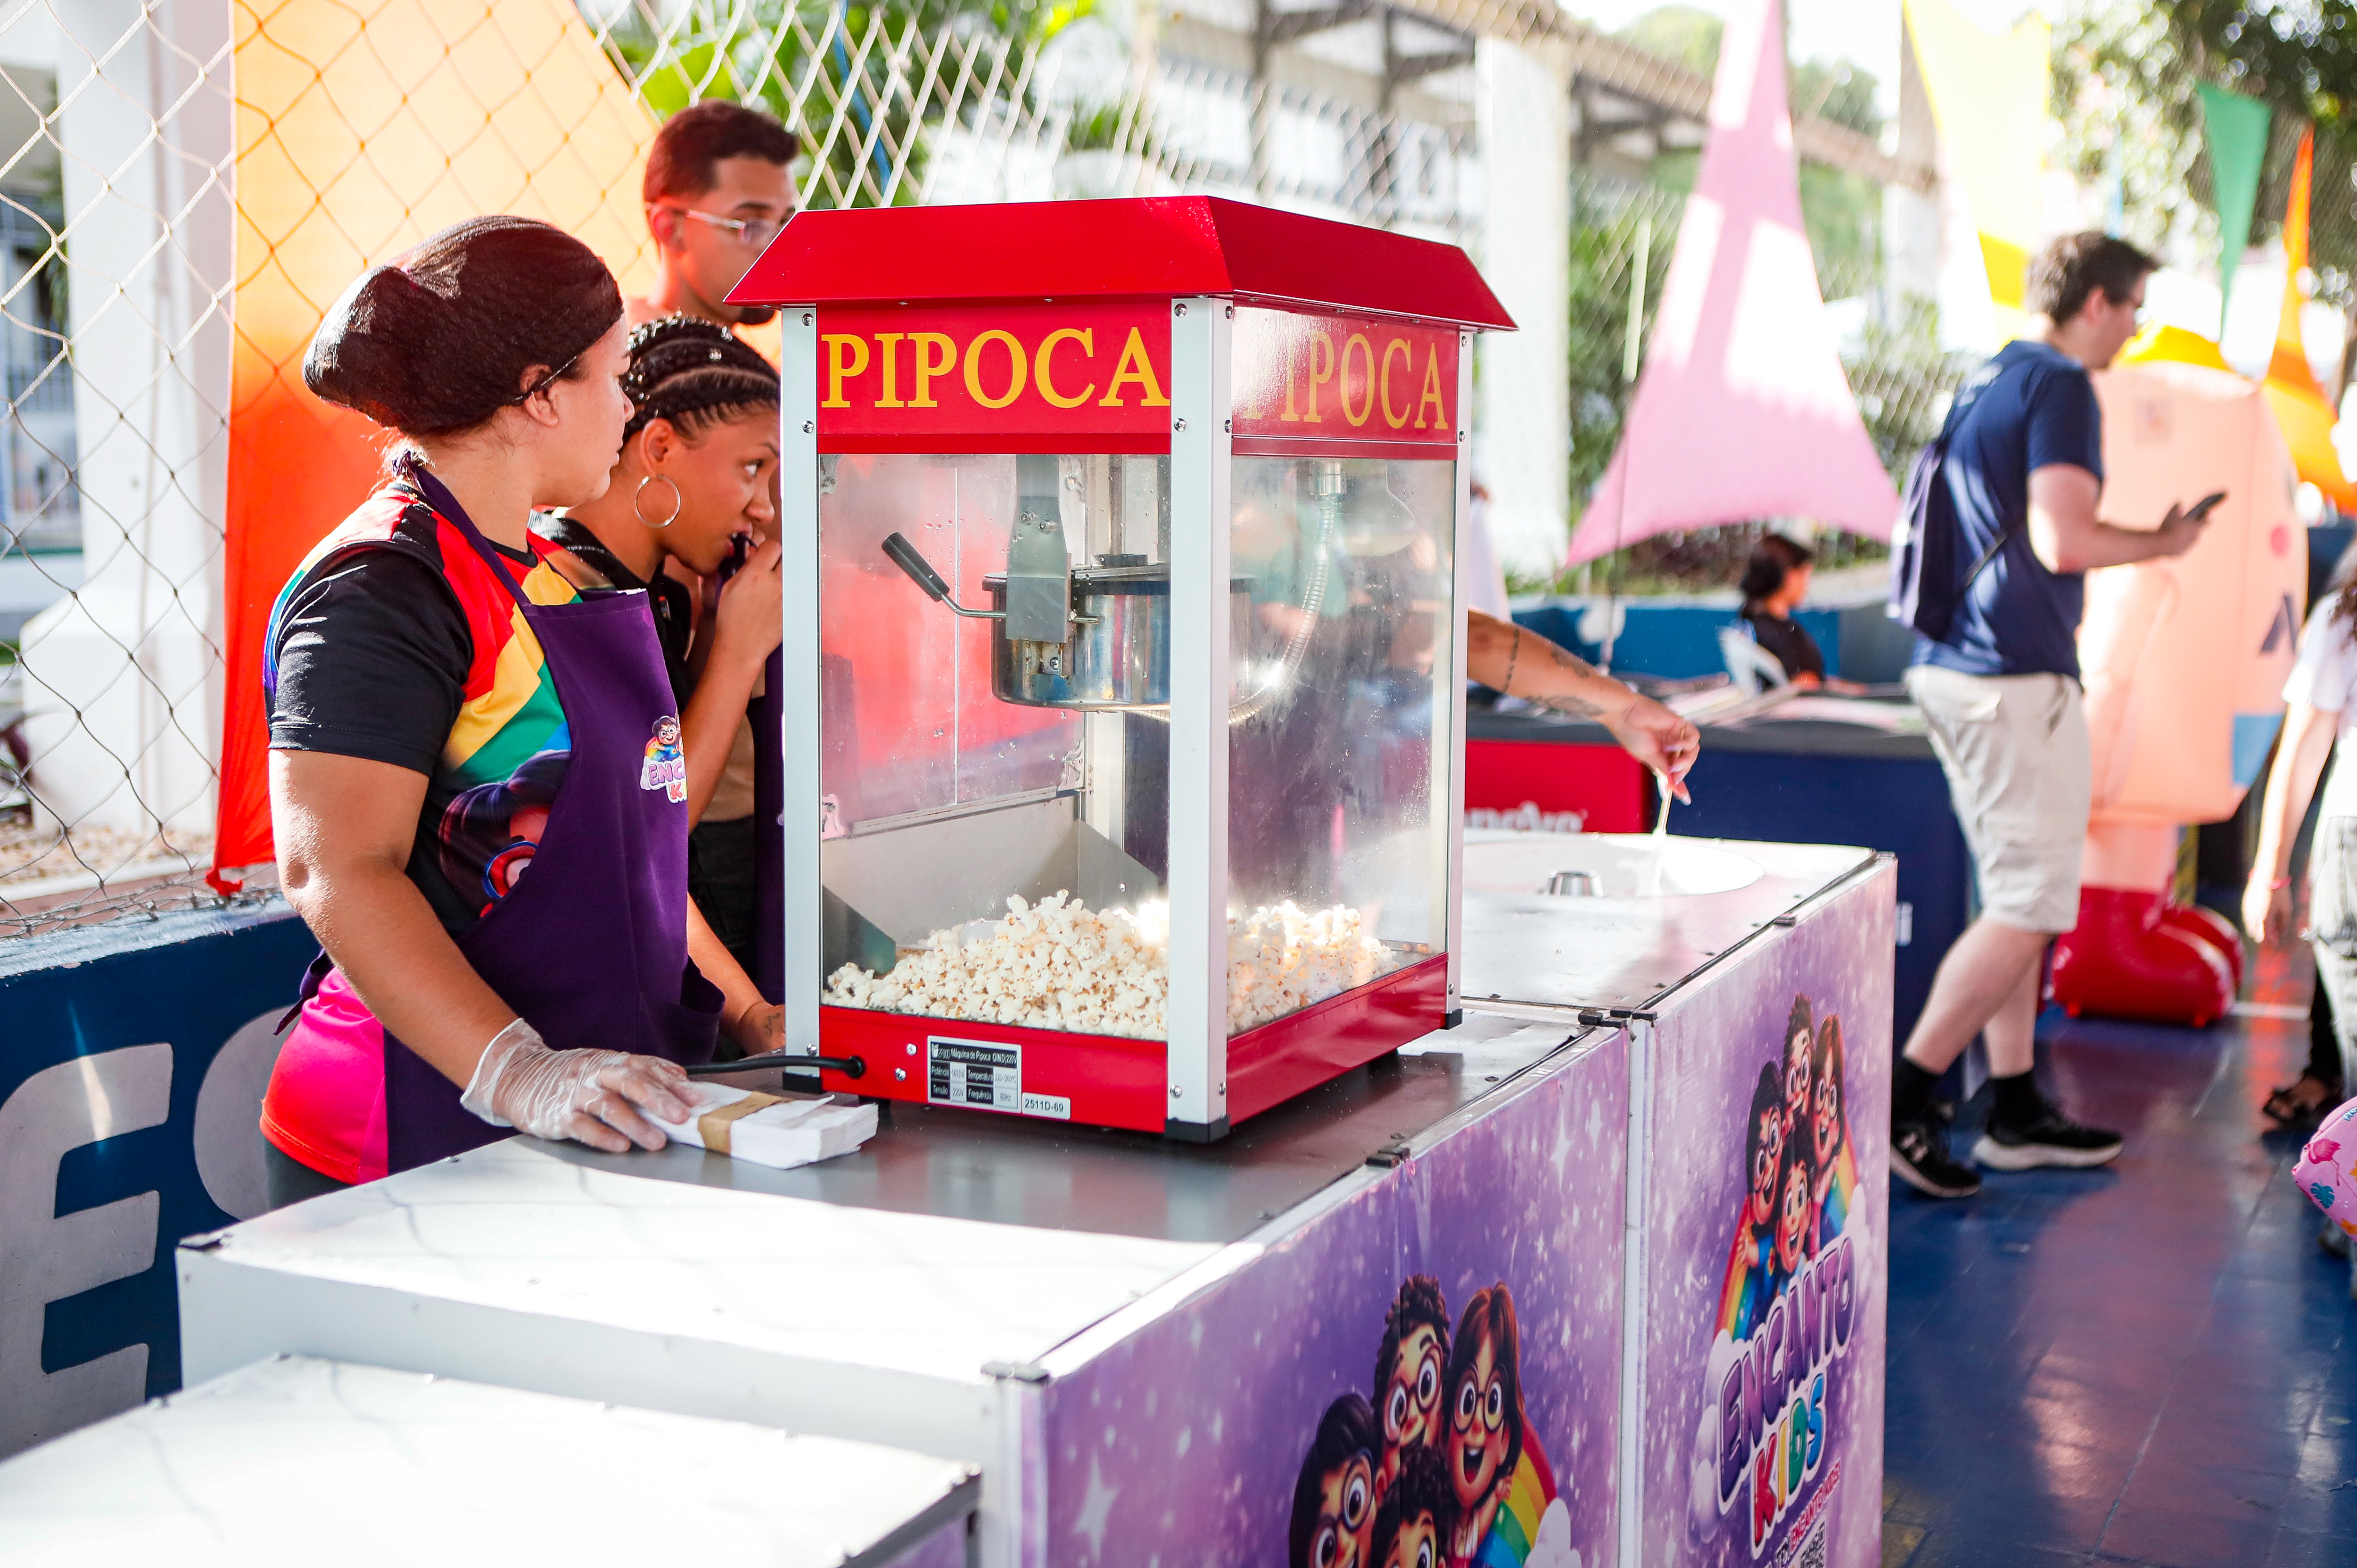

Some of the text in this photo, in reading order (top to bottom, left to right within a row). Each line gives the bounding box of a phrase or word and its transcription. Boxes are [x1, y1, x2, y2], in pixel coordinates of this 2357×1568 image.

[821, 326, 1170, 409] PIPOCA
[648, 760, 685, 786] ENC
[951, 1048, 969, 1060] Máquina
[970, 1051, 975, 1060] de
[976, 1051, 991, 1062] Pipoca
[931, 1066, 949, 1077] Potência
[968, 1069, 994, 1082] Temperatura
[933, 1084, 948, 1095] Tensão
[968, 1088, 992, 1100] Frequência
[1025, 1099, 1063, 1112] 2511D-69
[1720, 1237, 1855, 1503] ENCANTO
[1755, 1373, 1824, 1548] KIDS
